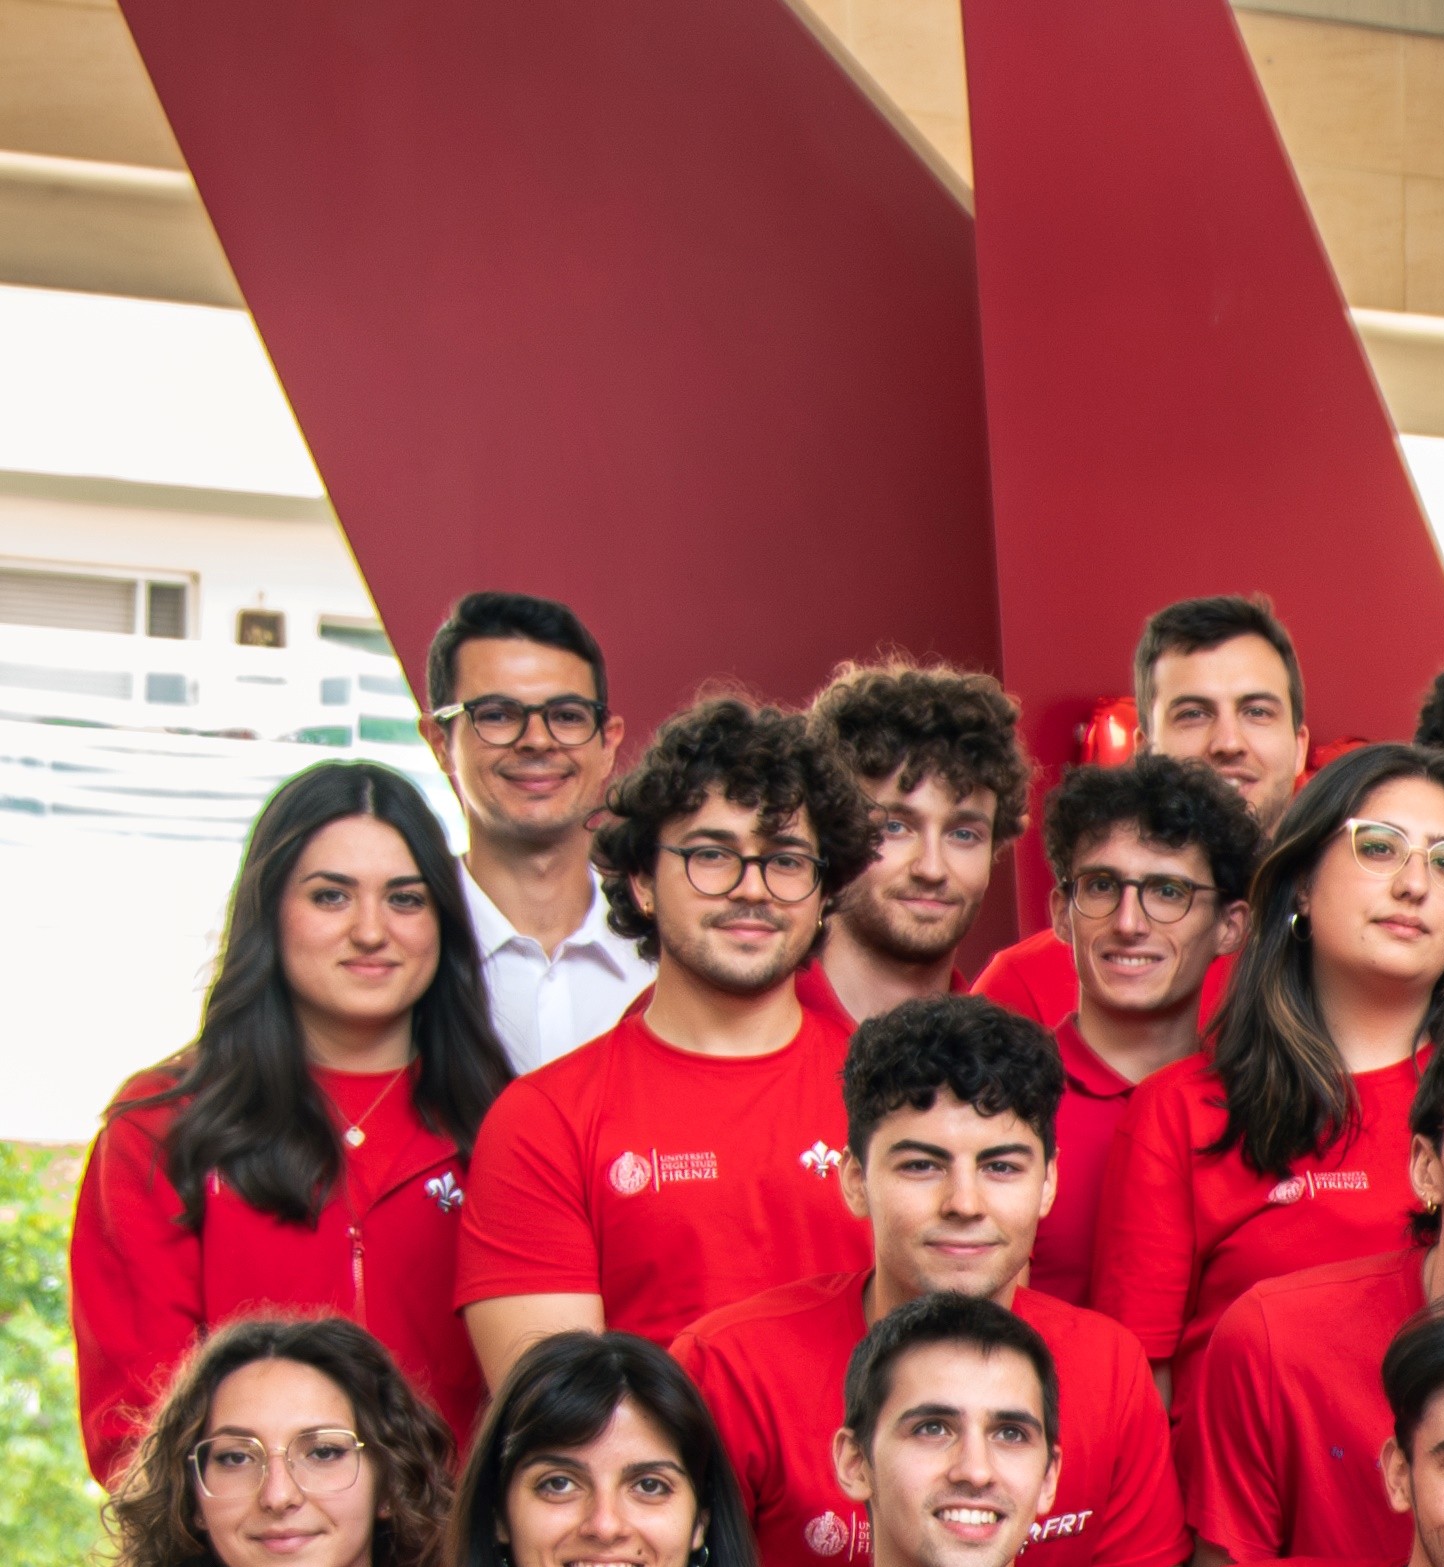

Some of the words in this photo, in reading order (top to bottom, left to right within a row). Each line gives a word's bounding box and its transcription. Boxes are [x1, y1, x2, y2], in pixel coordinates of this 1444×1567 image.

[660, 1161, 690, 1171] DEGLI
[692, 1160, 718, 1169] STUDI
[661, 1169, 719, 1182] FIRENZE
[1042, 1510, 1093, 1539] FRT
